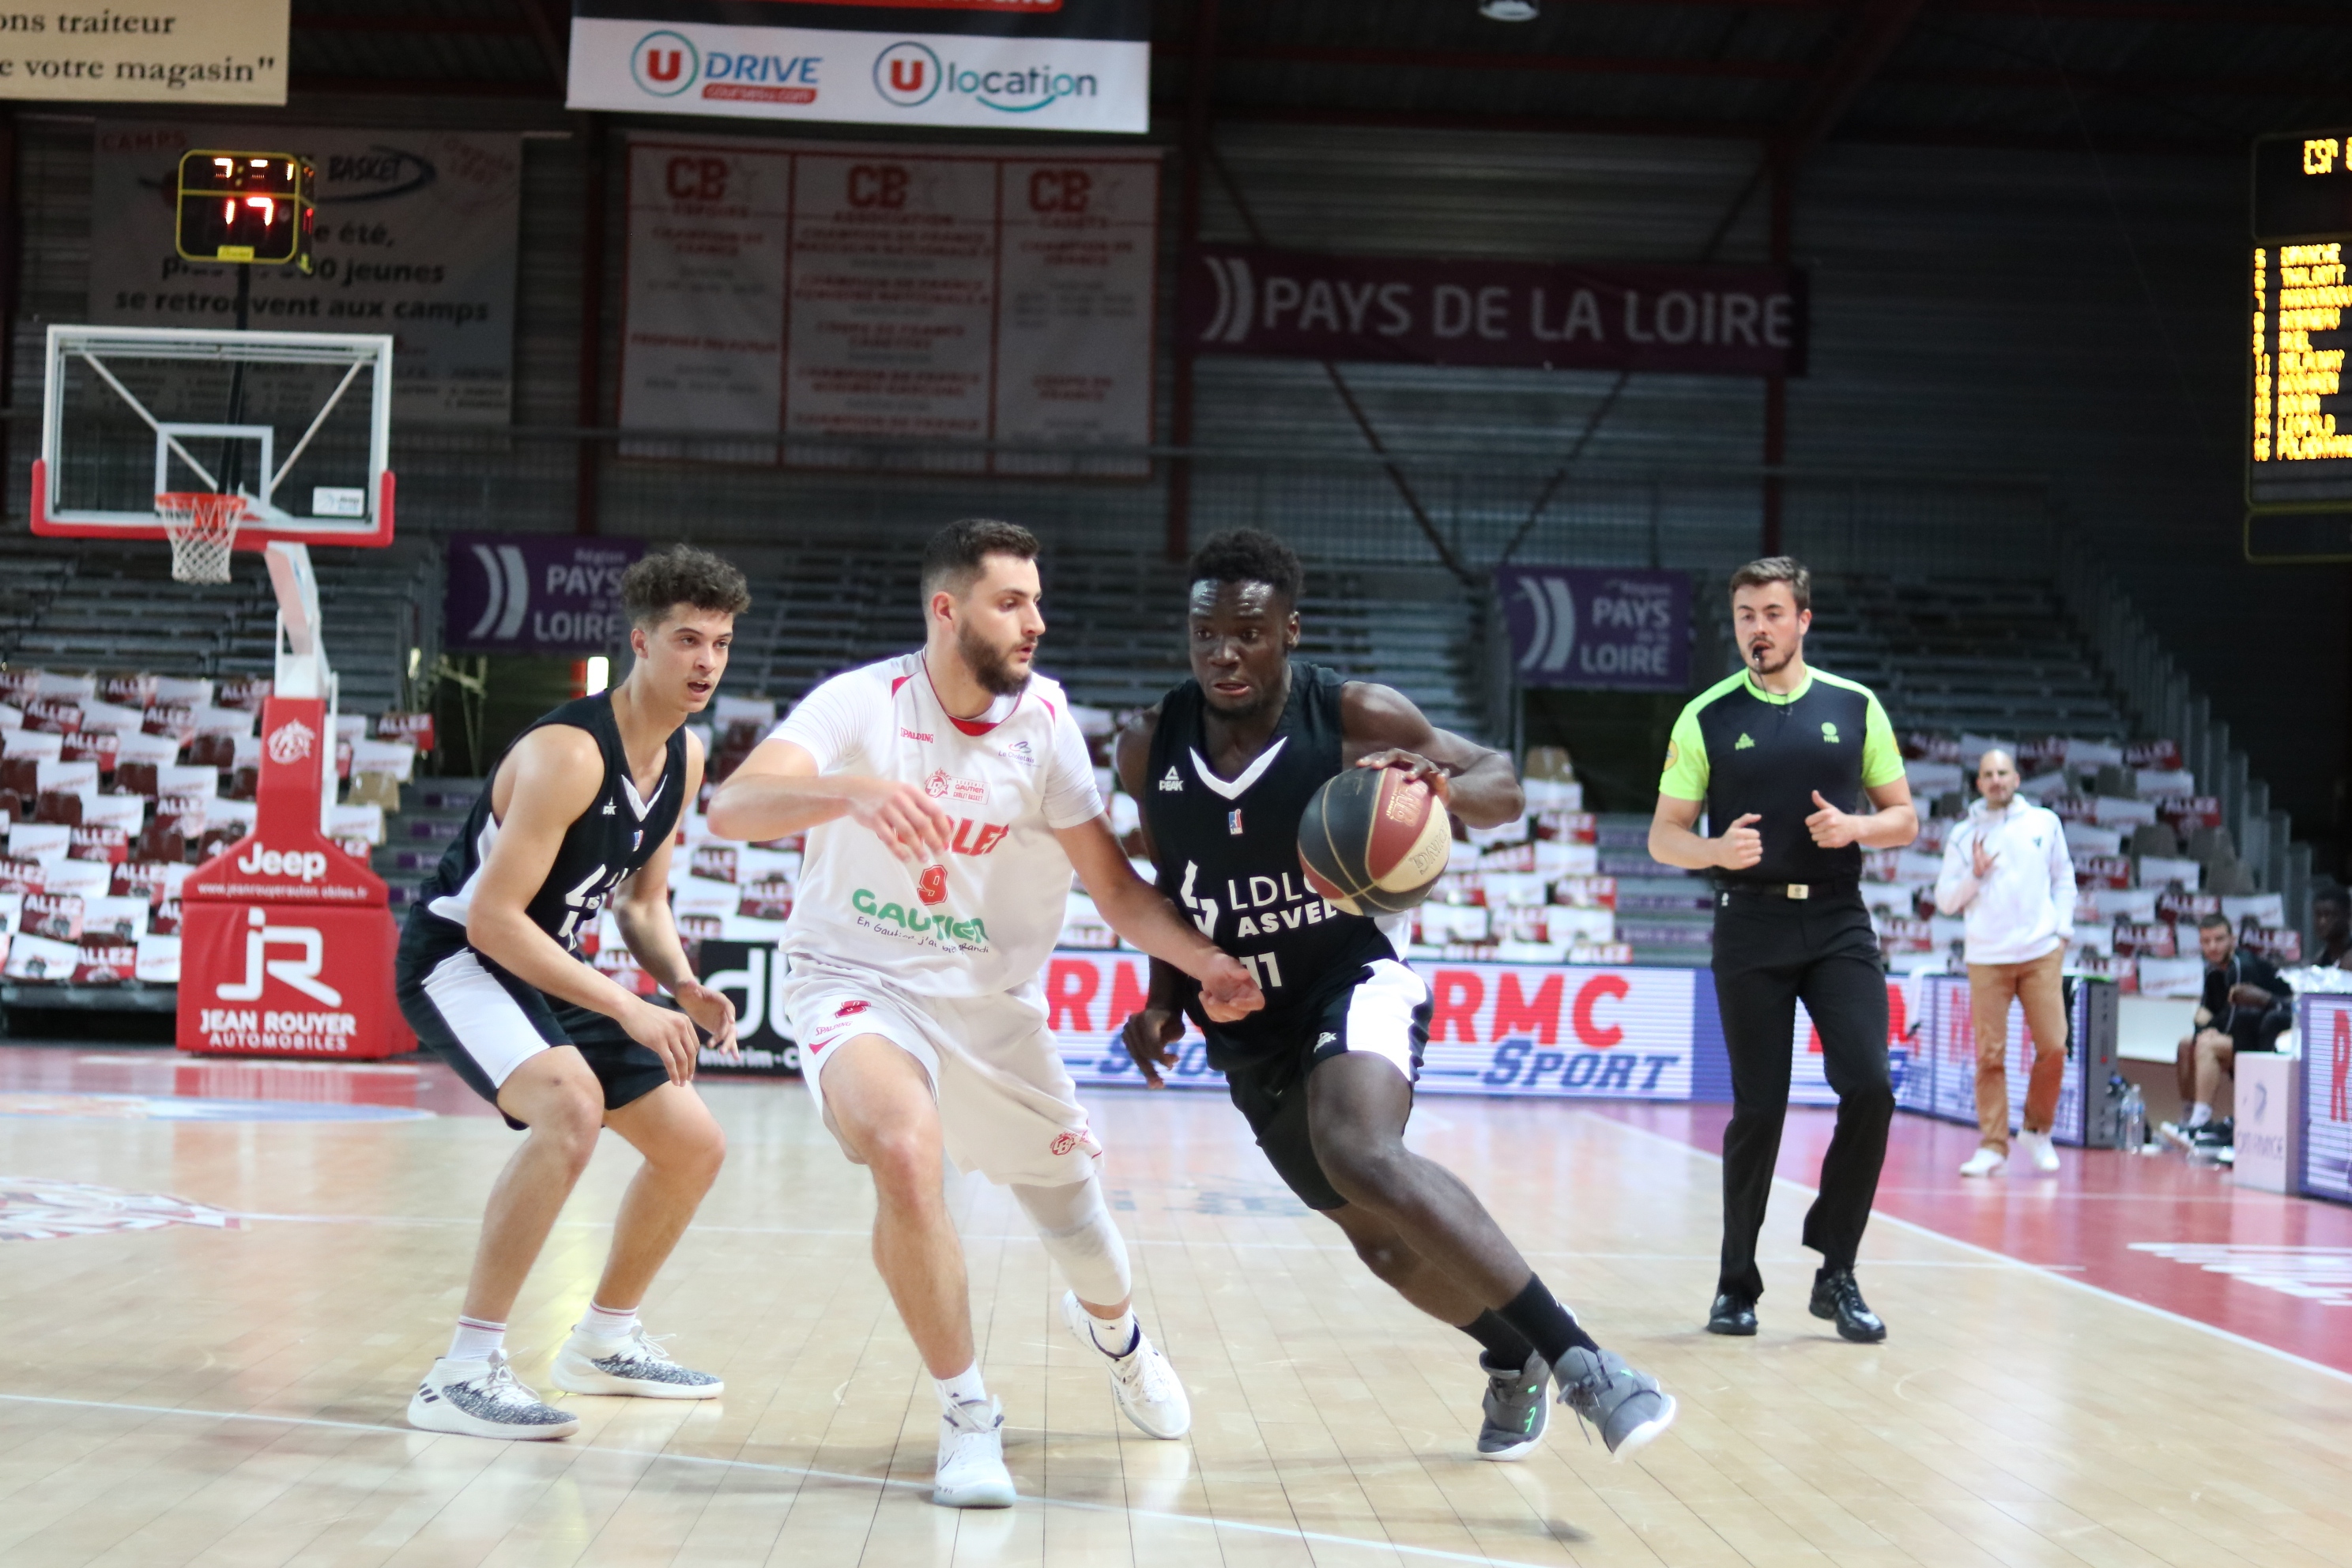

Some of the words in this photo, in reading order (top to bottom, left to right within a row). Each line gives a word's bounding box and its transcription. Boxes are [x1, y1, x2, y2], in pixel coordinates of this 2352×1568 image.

[58, 7, 176, 35] traiteur
[25, 56, 104, 79] votre
[115, 58, 275, 89] magasin"
[647, 49, 681, 82] U
[704, 51, 823, 84] DRIVE
[891, 60, 924, 92] U
[947, 62, 1098, 96] location
[327, 157, 398, 183] BASKET
[665, 158, 729, 200] CB
[847, 165, 907, 208] CB
[1029, 169, 1089, 213] CB
[338, 221, 394, 247] été,
[345, 258, 445, 285] jeunes
[115, 290, 149, 311] se
[330, 296, 384, 318] aux
[394, 300, 488, 325] camps
[1265, 277, 1413, 337] PAYS
[1433, 285, 1510, 340] DE
[1531, 288, 1603, 342] LA
[1626, 291, 1793, 348] LOIRE
[547, 564, 622, 597] PAYS
[533, 611, 621, 643] LOIRE
[1592, 597, 1672, 629] PAYS
[1581, 643, 1669, 677] LOIRE
[379, 714, 431, 733] ALLEZ
[900, 727, 933, 744] SPALDING
[65, 731, 118, 750] ALLEZ
[1159, 779, 1184, 792] PEAK
[72, 827, 127, 846] ALLEZ
[238, 842, 326, 883] Jeep
[917, 865, 948, 906] 9
[24, 894, 83, 914] ALLEZ
[1237, 899, 1337, 938] ASVEL
[858, 917, 870, 928] En
[873, 924, 917, 940] Gauti
[78, 947, 134, 966] ALLEZ
[1238, 952, 1282, 989] 11
[200, 1009, 258, 1034] JEAN
[264, 1011, 356, 1036] ROUYER
[1429, 969, 1630, 1050] RMC
[209, 1032, 349, 1052] AUTOMOBILES
[815, 1020, 853, 1036] SPALDING
